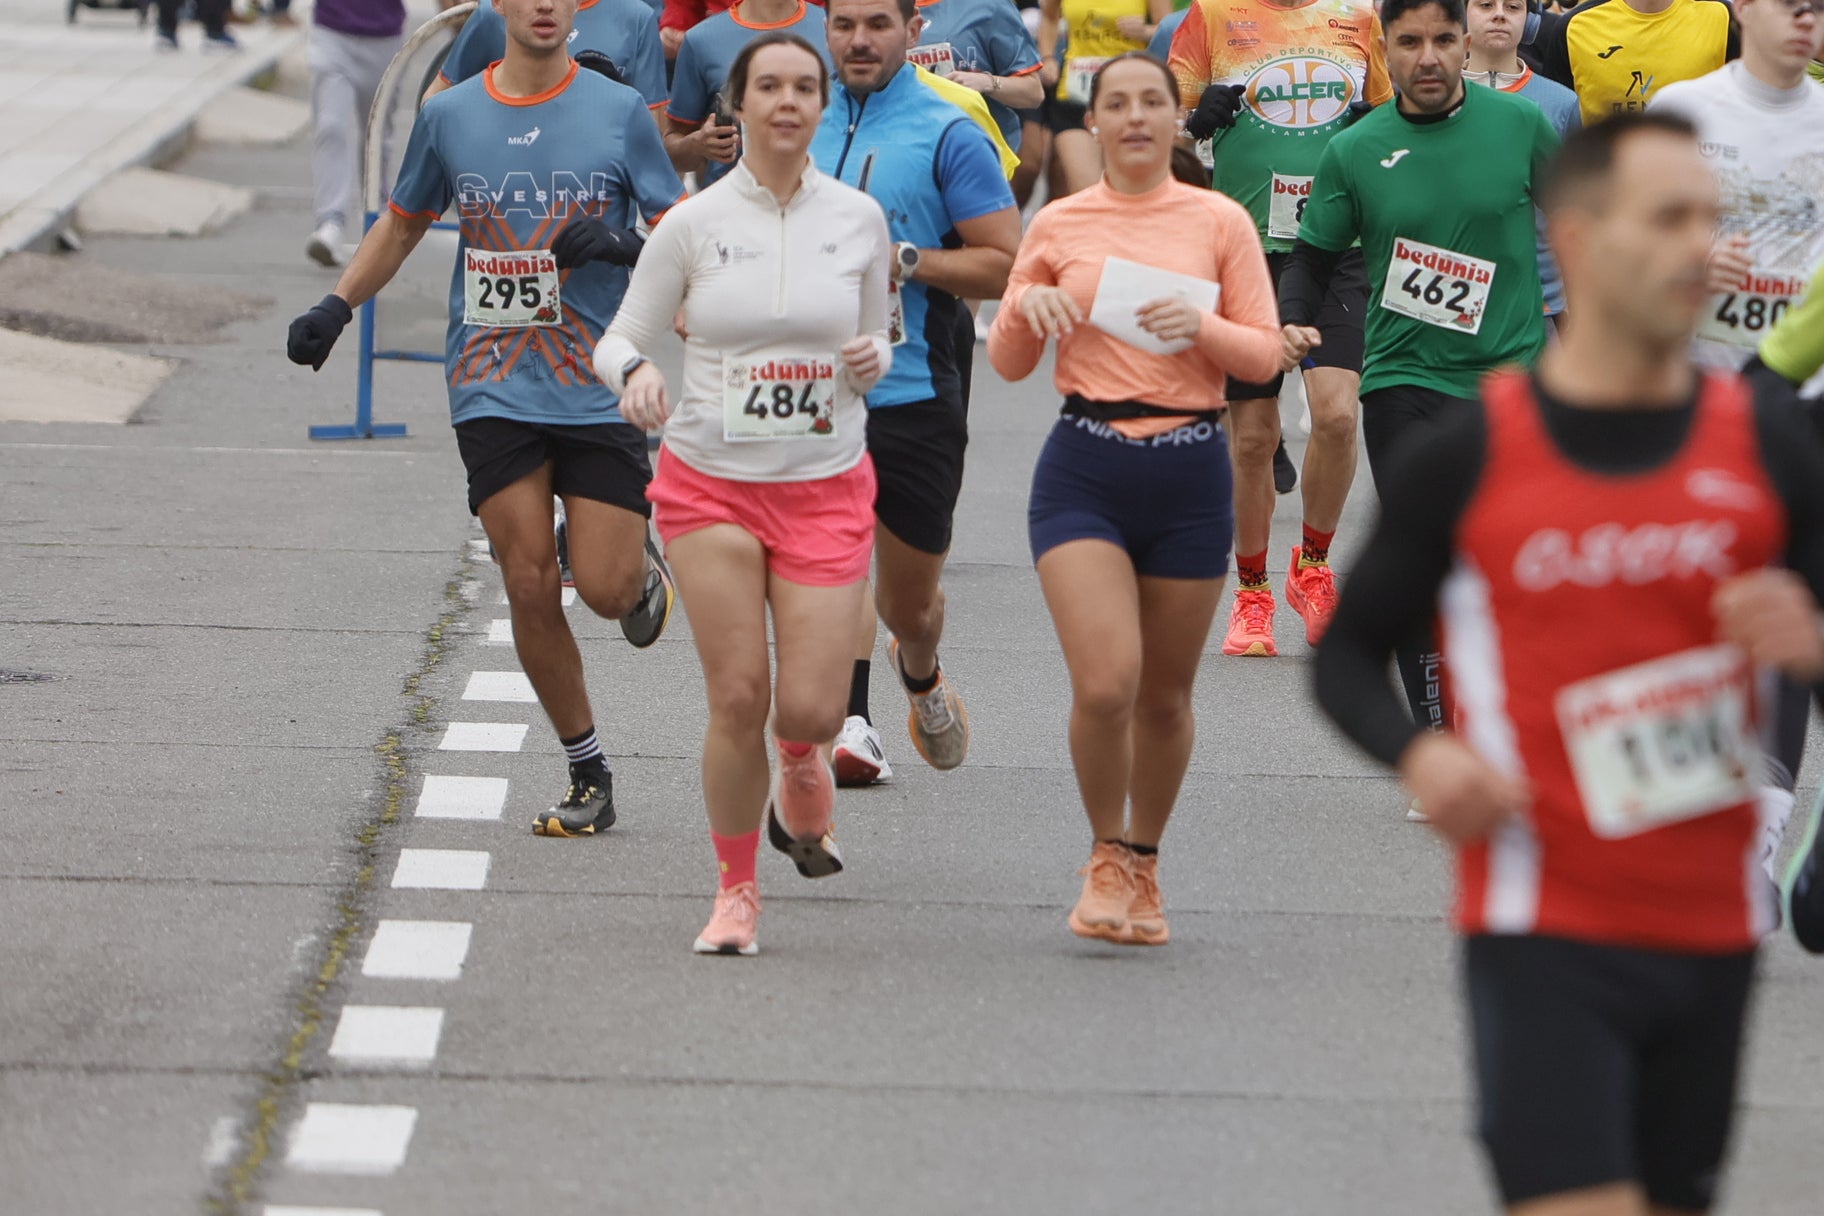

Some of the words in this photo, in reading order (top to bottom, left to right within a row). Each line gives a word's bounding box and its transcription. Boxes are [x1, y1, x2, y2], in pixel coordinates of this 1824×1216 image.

[1243, 53, 1273, 77] CLUB
[1280, 47, 1353, 70] DEPORTIVO
[1255, 81, 1346, 103] ALCER
[456, 171, 607, 219] SAN
[467, 251, 555, 276] bedunia
[1395, 241, 1491, 285] bedunia
[478, 276, 541, 310] 295
[1401, 268, 1470, 313] 462
[750, 359, 833, 381] dunia
[743, 381, 819, 420] 484
[1151, 421, 1213, 448] PRO
